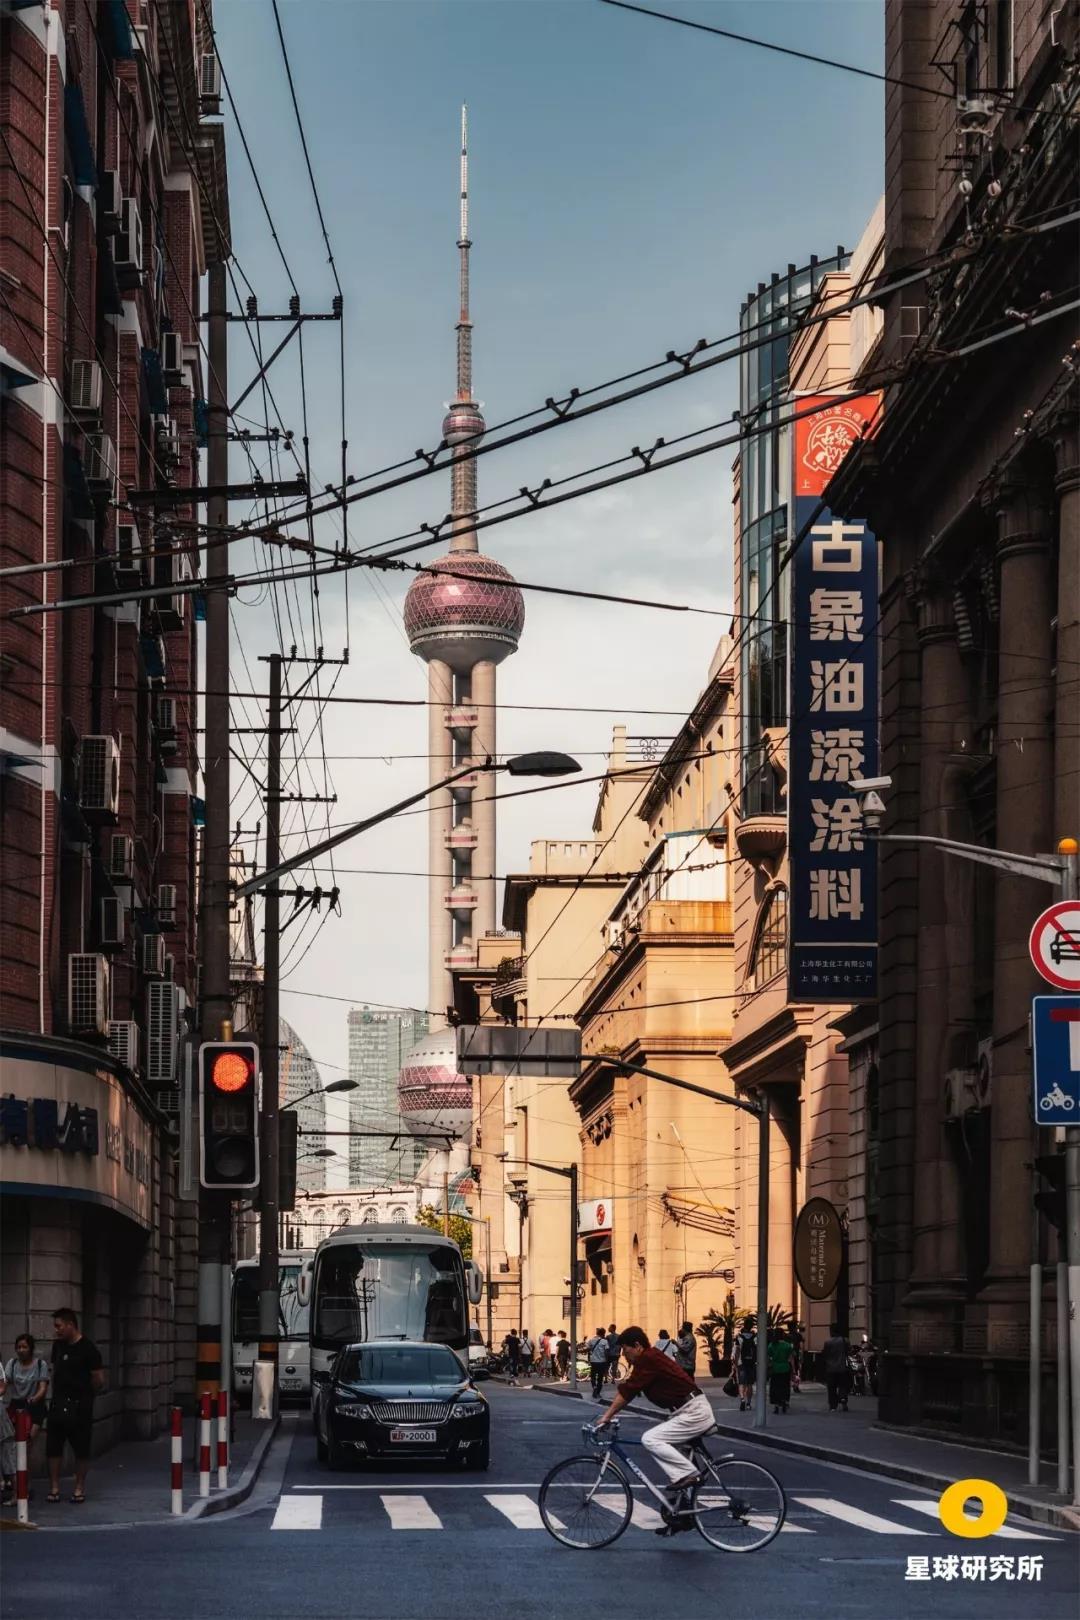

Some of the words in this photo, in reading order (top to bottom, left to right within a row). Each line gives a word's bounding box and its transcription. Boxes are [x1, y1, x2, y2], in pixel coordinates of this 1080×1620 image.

[809, 520, 865, 921] 古象油漆涂料
[818, 1229, 827, 1266] Maternal
[818, 1269, 827, 1288] Care
